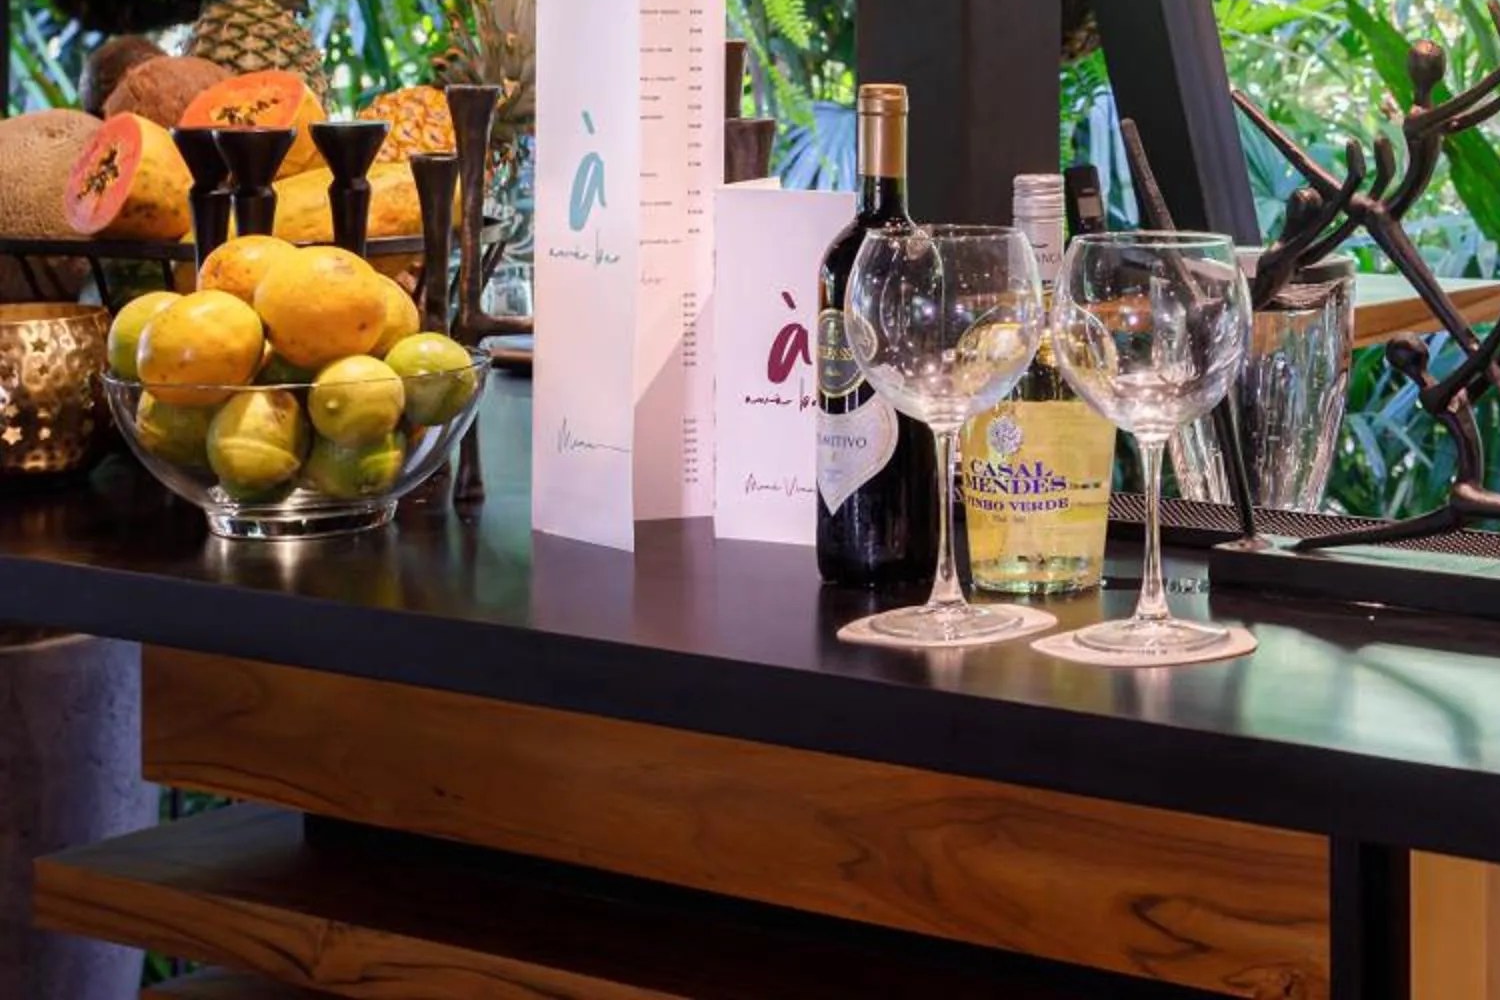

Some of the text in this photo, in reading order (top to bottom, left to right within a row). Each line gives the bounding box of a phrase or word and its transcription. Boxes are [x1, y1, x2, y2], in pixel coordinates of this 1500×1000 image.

[767, 291, 812, 385] à
[970, 458, 1054, 479] CASAL
[965, 472, 1067, 495] MENDES
[1010, 498, 1069, 512] VERDE
